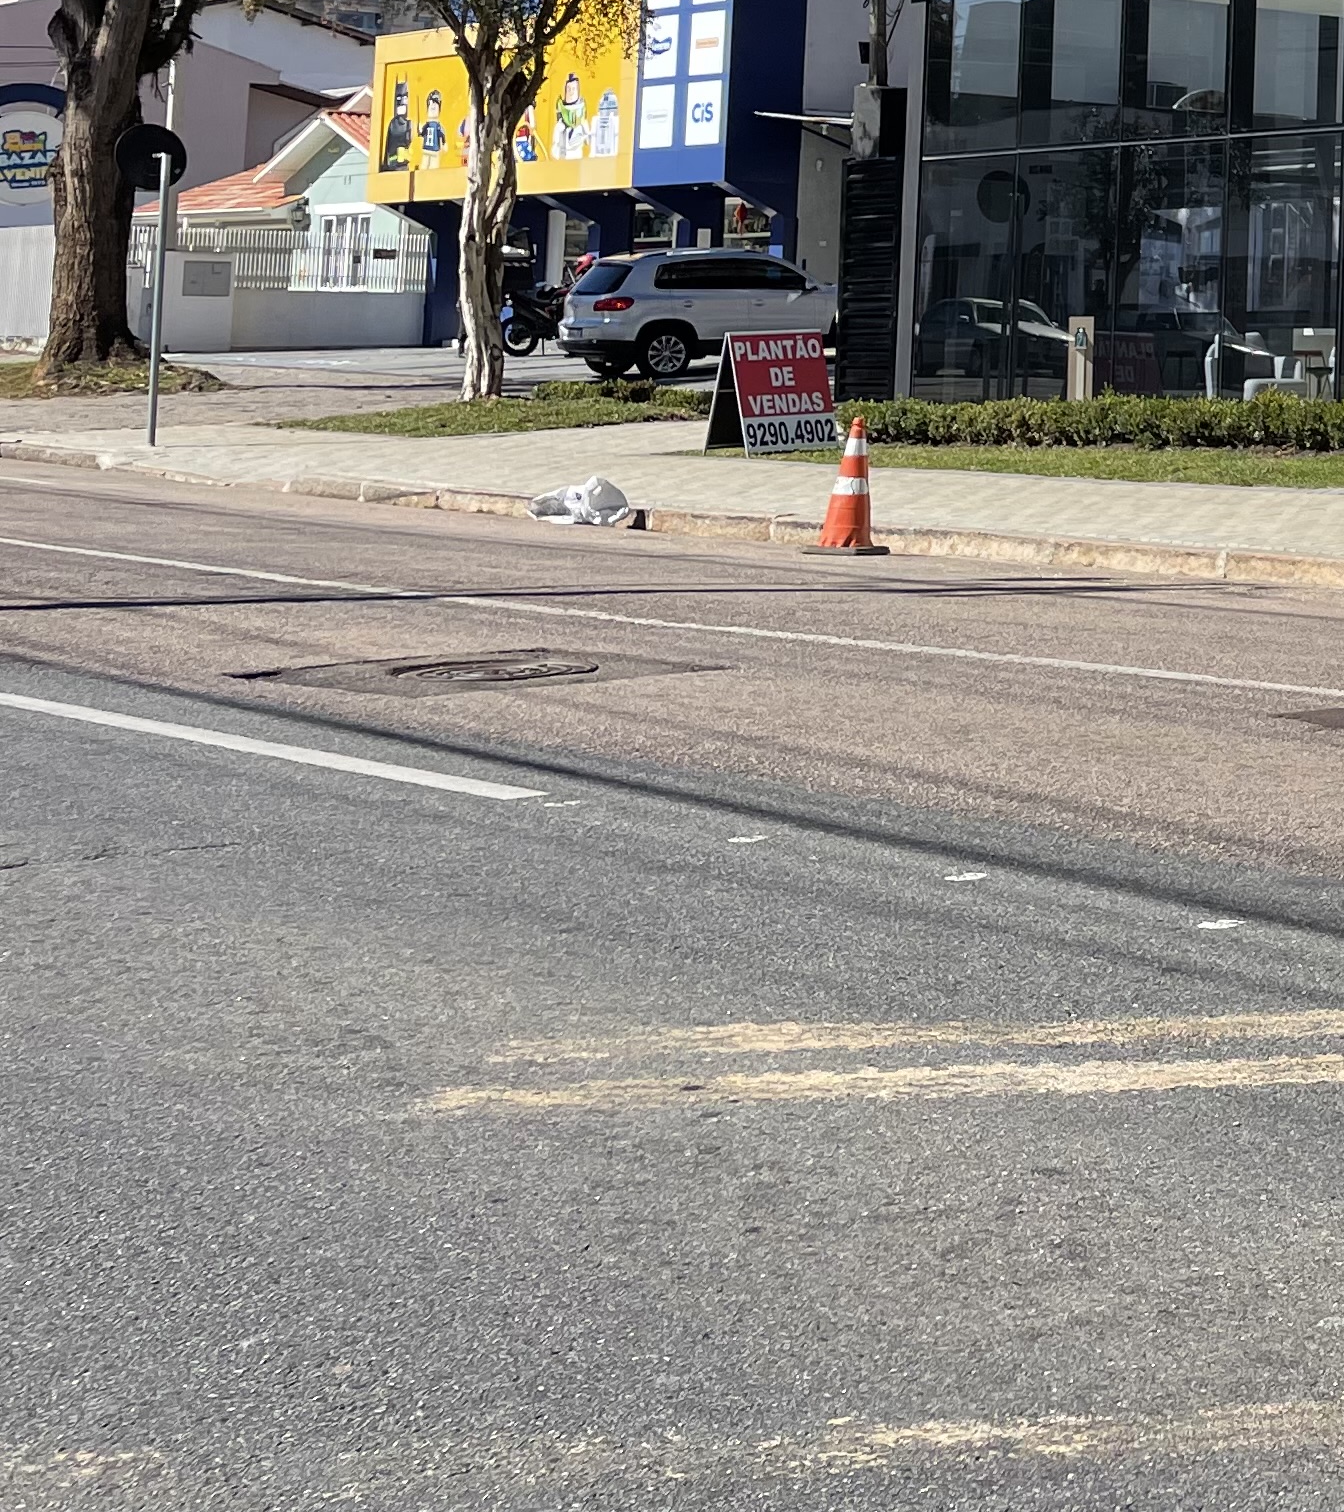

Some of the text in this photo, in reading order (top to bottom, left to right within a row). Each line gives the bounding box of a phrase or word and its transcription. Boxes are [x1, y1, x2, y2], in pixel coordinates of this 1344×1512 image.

[733, 335, 821, 362] PLANTÃO
[769, 366, 796, 387] DE
[747, 391, 825, 415] VENDAS
[746, 418, 837, 448] 9290.4902
